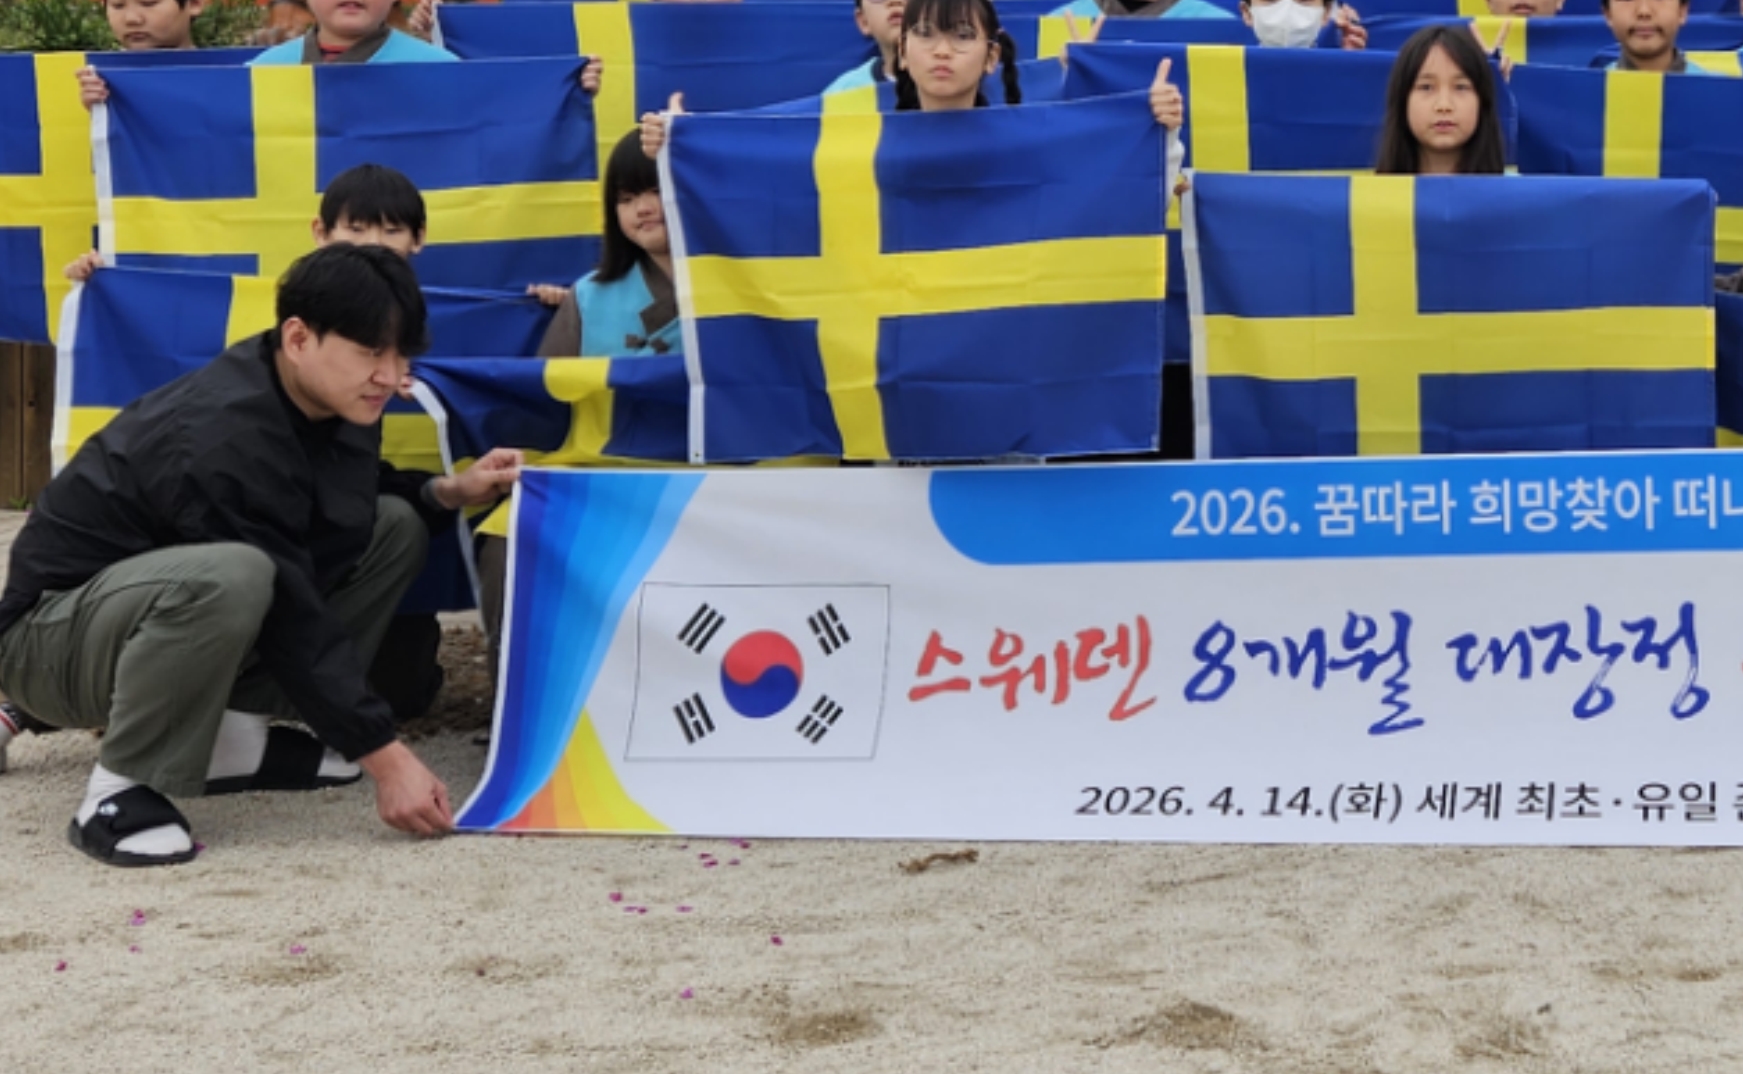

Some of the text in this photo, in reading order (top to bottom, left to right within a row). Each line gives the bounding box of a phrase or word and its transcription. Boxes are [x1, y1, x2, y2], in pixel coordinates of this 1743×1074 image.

[1171, 489, 1300, 537] 2026.
[1315, 481, 1456, 536] 꿈따라
[1469, 478, 1661, 533] 희망찾아
[908, 616, 1156, 722] 스웨덴
[1183, 610, 1425, 737] 8개월
[1445, 601, 1711, 721] 대장정
[1075, 785, 1194, 817] 2026.
[1207, 785, 1245, 817] 4.
[1261, 781, 1403, 823] 14.(화)
[1416, 781, 1503, 821] 세계
